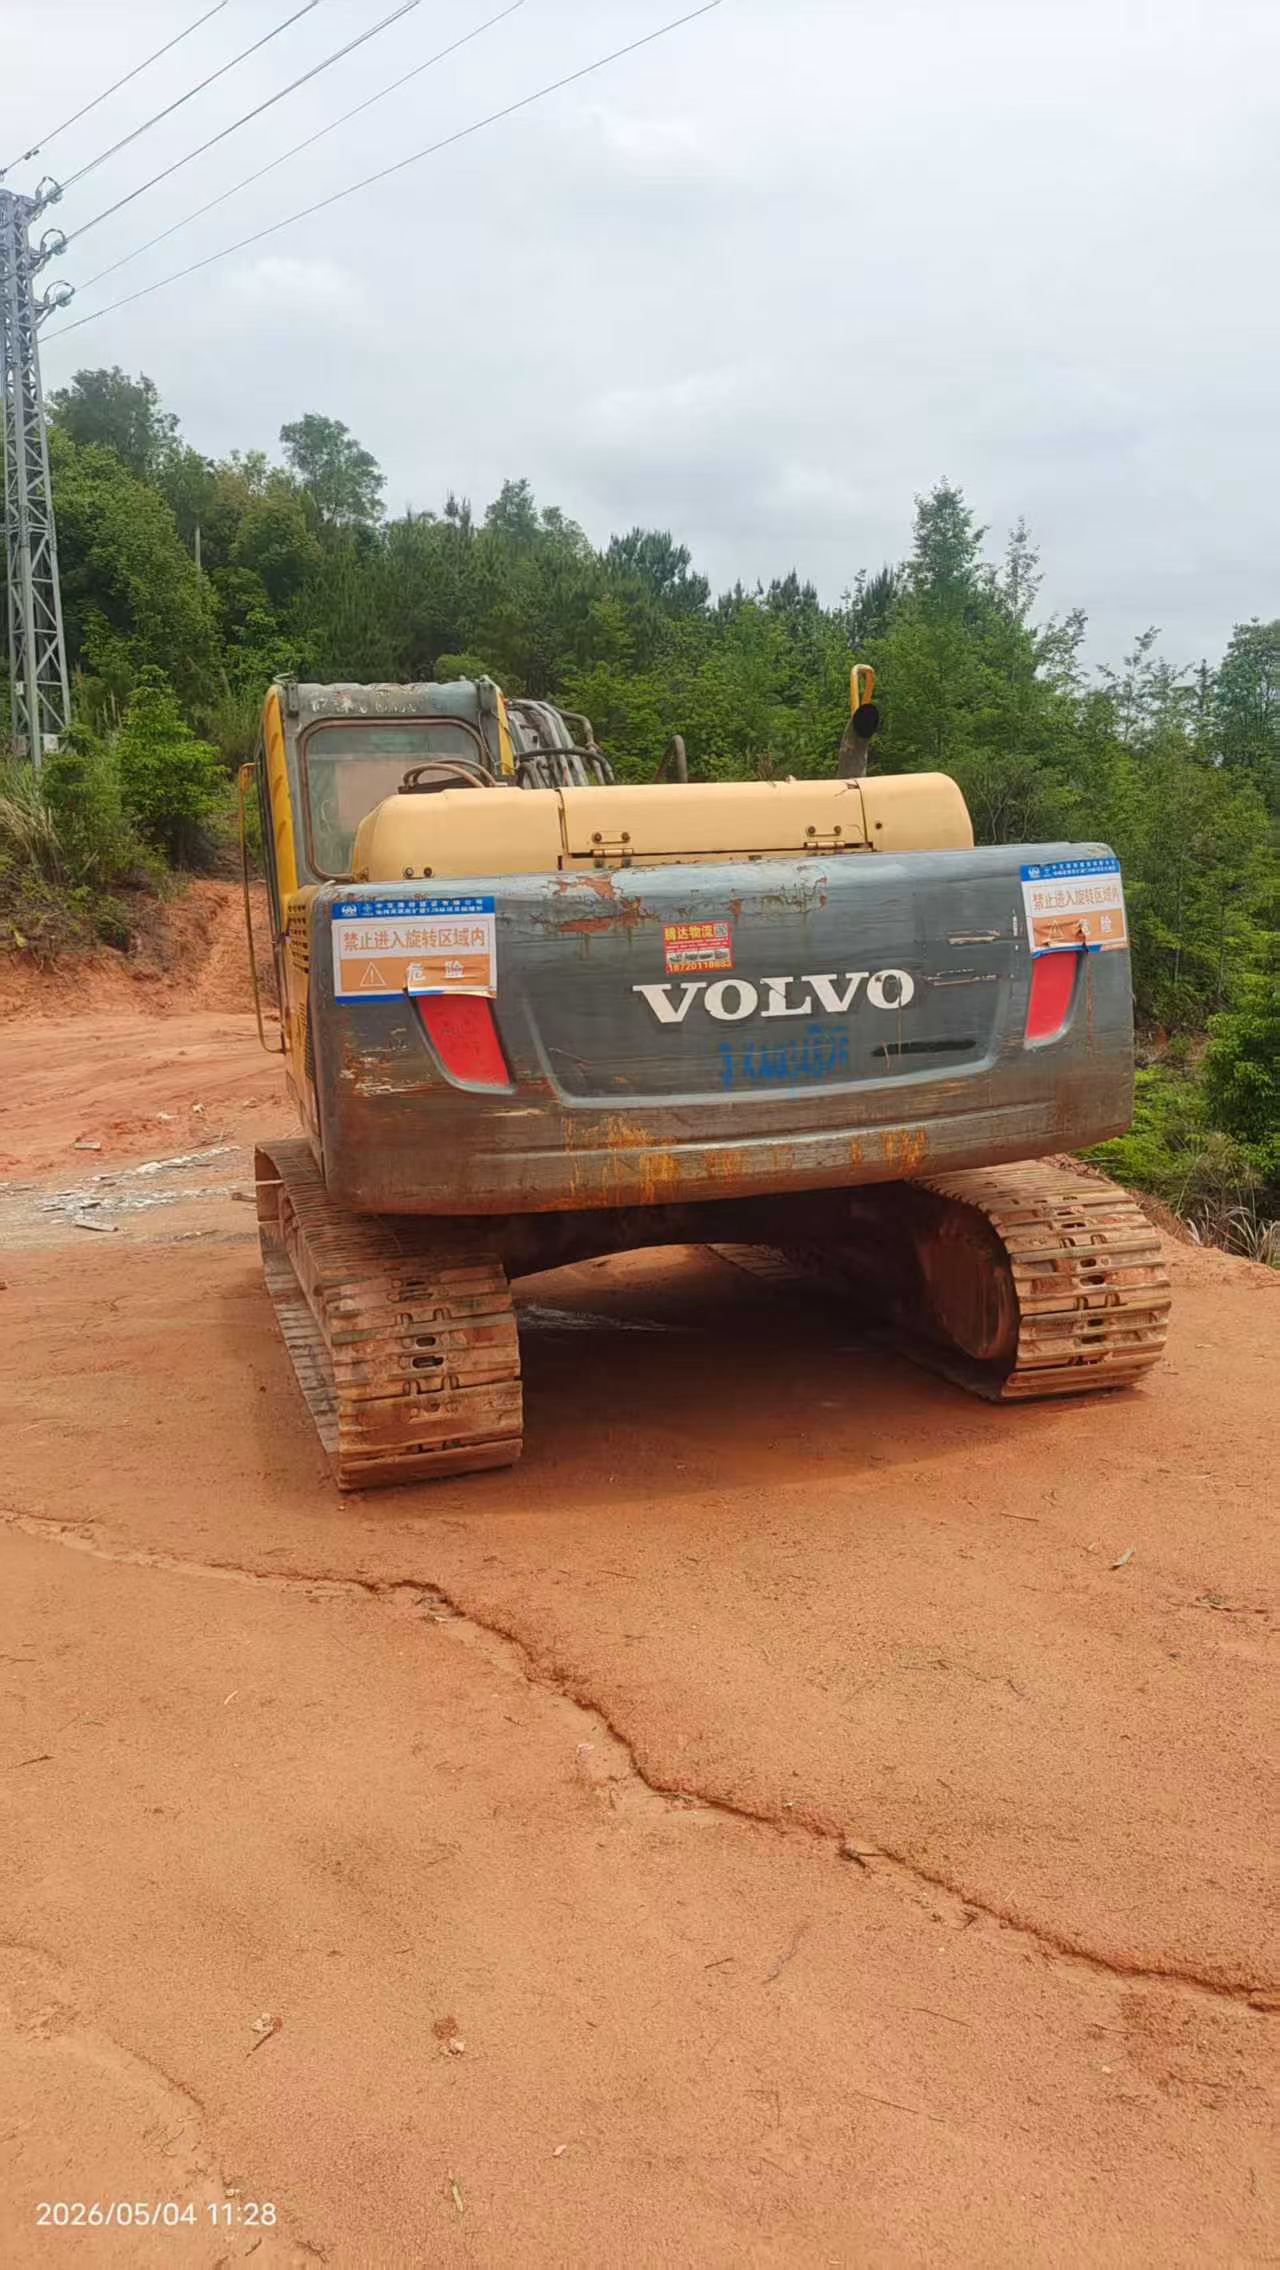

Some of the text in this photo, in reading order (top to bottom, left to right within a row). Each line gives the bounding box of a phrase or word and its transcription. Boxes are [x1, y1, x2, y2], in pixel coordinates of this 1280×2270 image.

[343, 927, 485, 951] 禁止进入旋转区域内
[407, 960, 465, 981] 危险
[632, 969, 915, 1024] VOLVO
